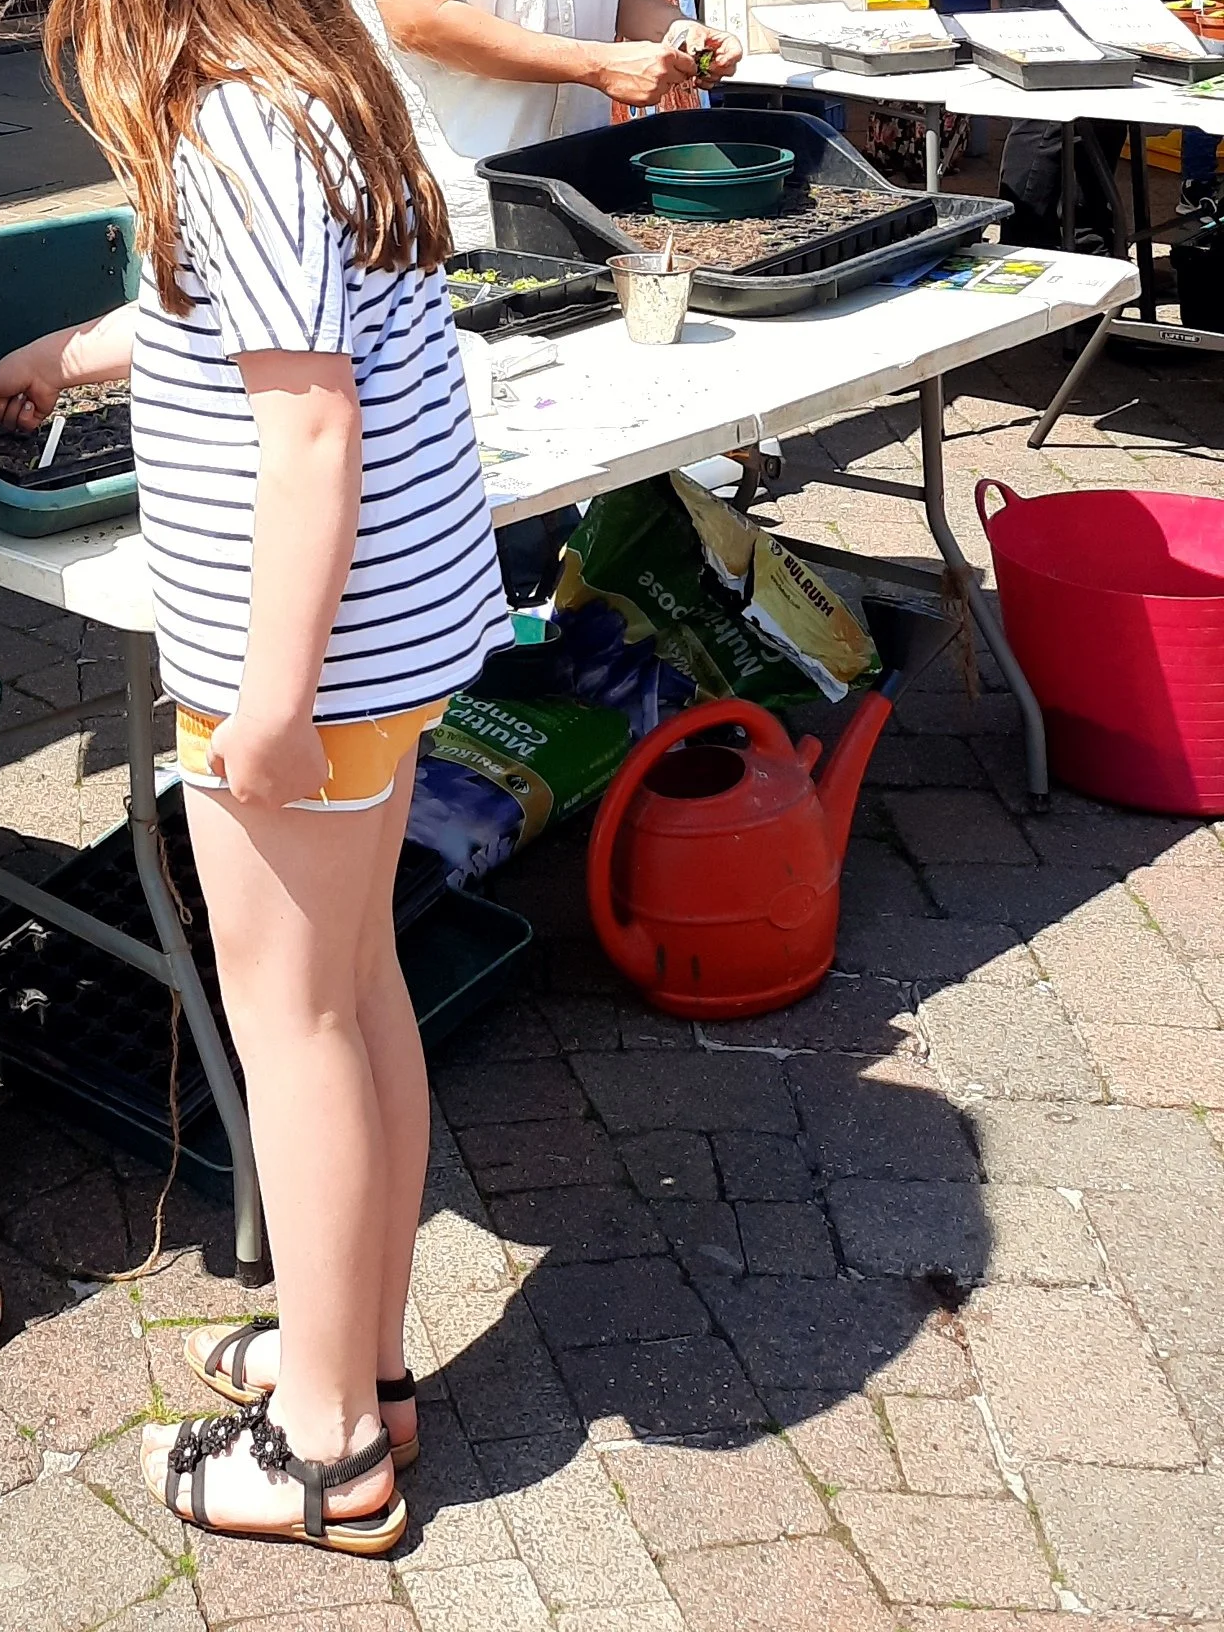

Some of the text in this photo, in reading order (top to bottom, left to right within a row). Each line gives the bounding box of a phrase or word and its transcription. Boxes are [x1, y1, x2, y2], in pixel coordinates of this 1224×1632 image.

[783, 554, 835, 617] BULRUSH
[448, 706, 536, 759] Multip
[455, 690, 548, 745] Compo
